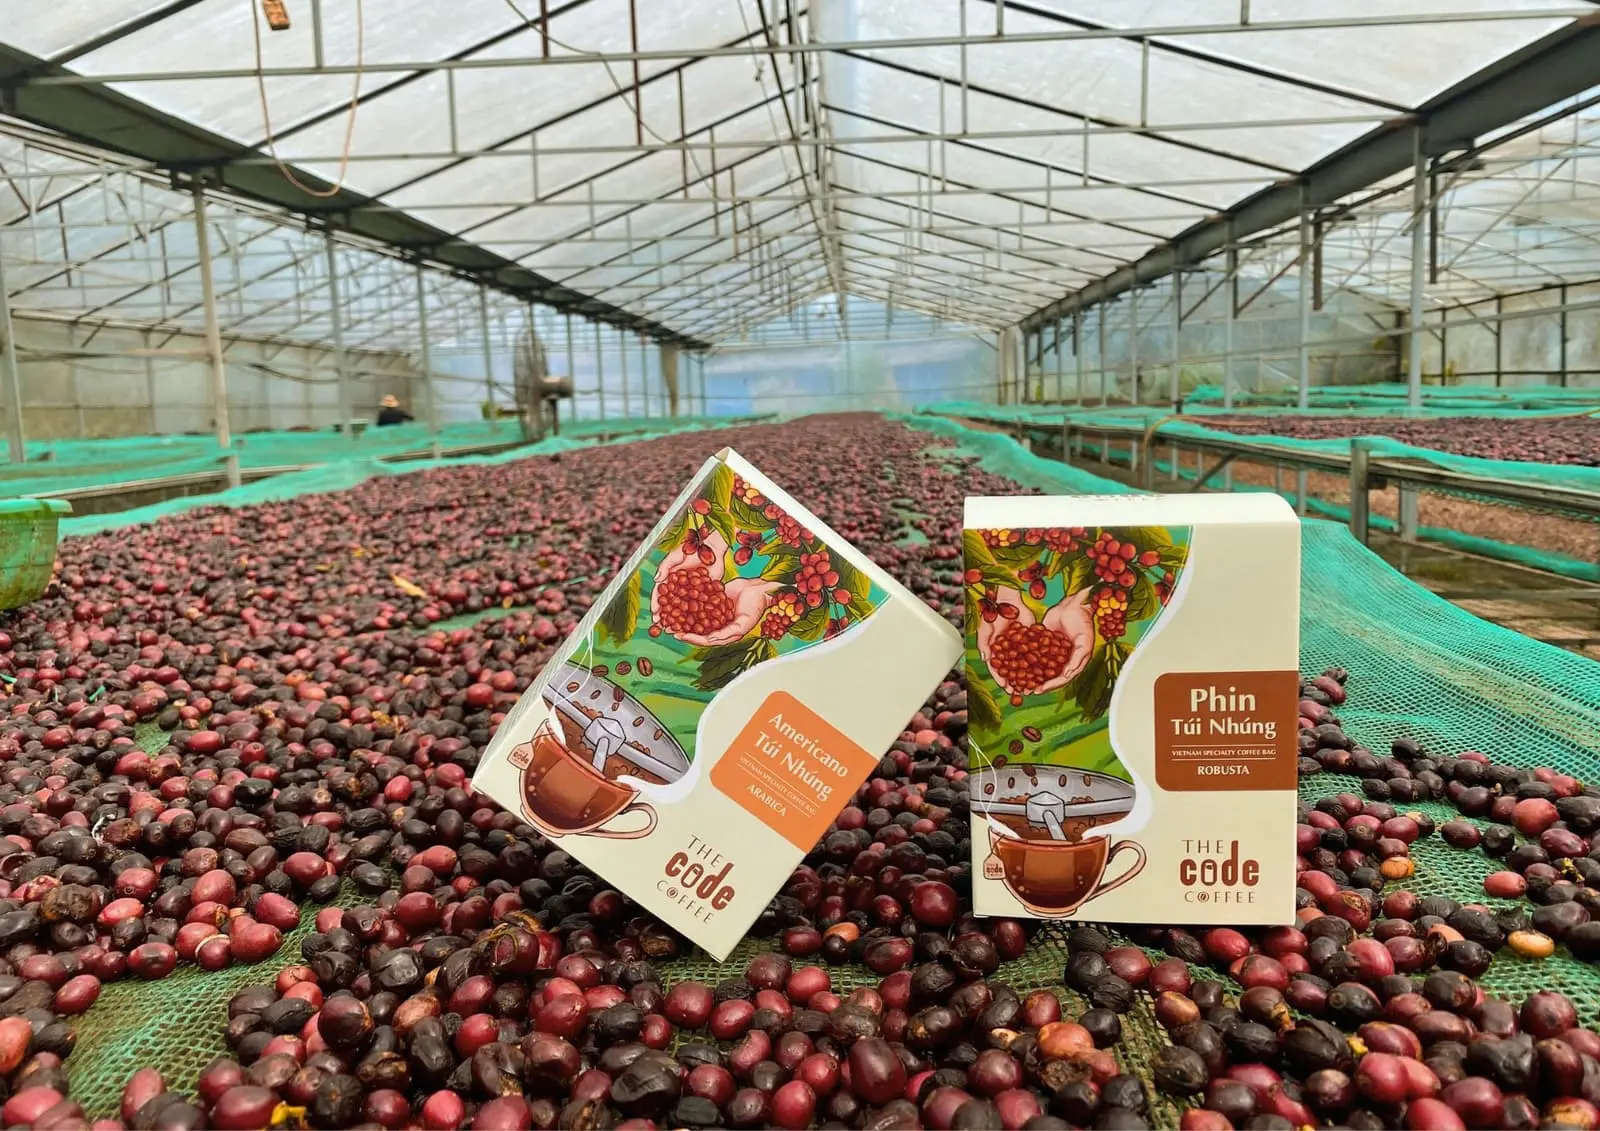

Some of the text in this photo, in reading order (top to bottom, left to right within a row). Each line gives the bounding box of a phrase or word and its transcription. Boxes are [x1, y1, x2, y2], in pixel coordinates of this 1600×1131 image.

[1190, 686, 1256, 712] Phin
[1171, 717, 1276, 740] Túi Nhúng
[768, 713, 849, 778] Americano
[754, 731, 833, 802] Túi Nhúng
[1197, 765, 1250, 776] ROBUSTA
[746, 784, 786, 817] ARABICA
[688, 834, 723, 867] THE
[1180, 840, 1259, 886] code
[1182, 839, 1224, 854] THE
[665, 851, 735, 910] code
[656, 880, 714, 924] COFFEE
[1184, 891, 1255, 904] COFFEE
